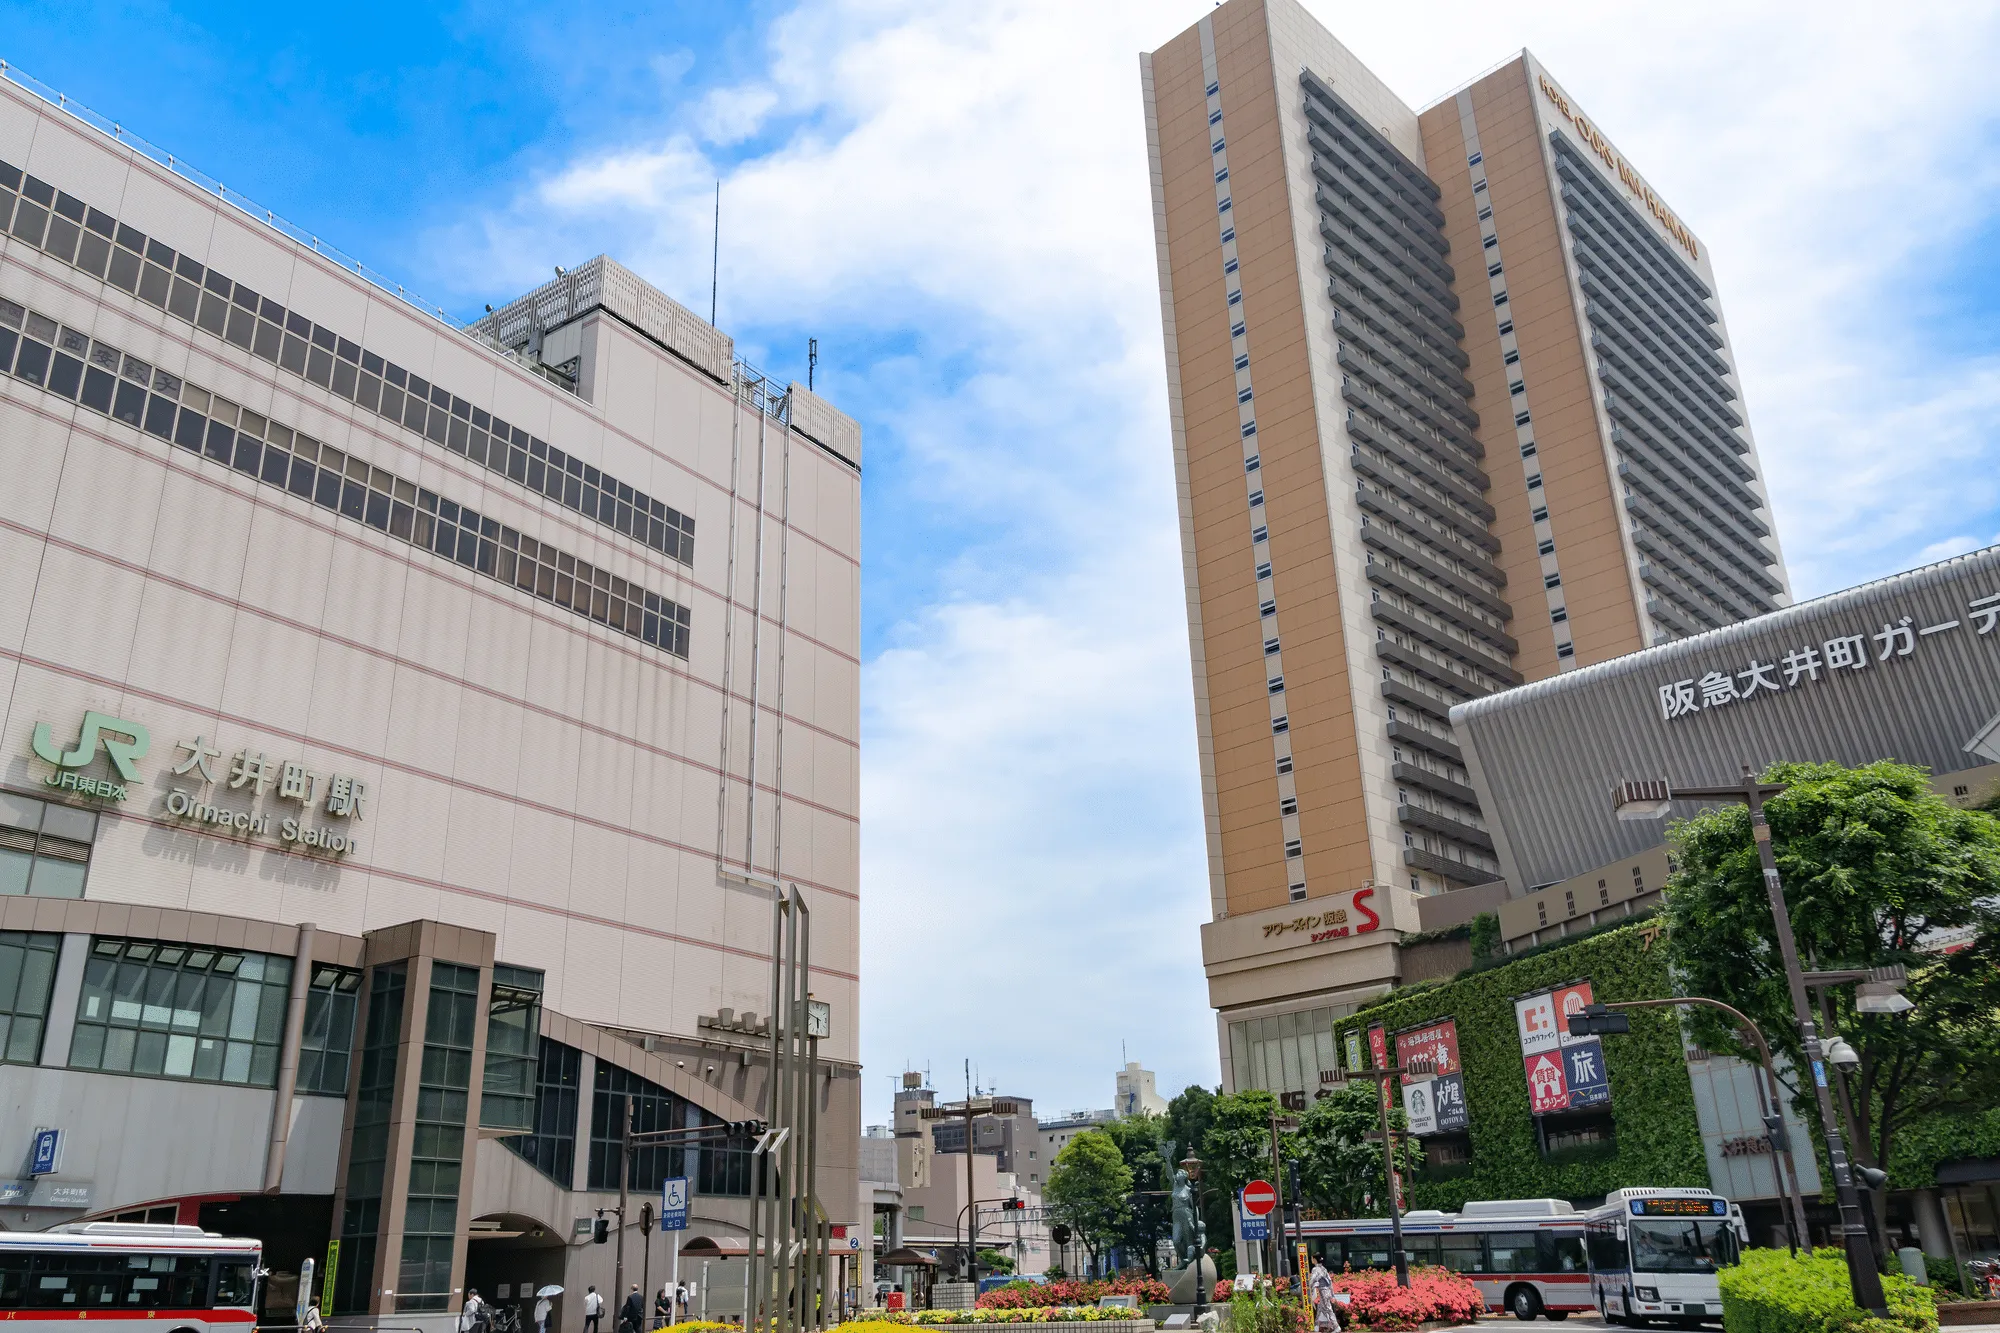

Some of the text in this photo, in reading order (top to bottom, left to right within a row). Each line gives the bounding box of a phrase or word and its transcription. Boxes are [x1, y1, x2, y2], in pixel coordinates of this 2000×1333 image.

[32, 710, 151, 784] JR
[45, 770, 129, 802] JR東日本
[171, 736, 370, 822] 大井町駅
[281, 816, 358, 856] Station
[1523, 1031, 1556, 1045] ココカラファイン
[1535, 1066, 1557, 1085] 賃貸
[1571, 1050, 1598, 1084] 旅
[1436, 1079, 1463, 1113] 大戸屋
[1411, 1115, 1432, 1125] STARBUCKS
[1415, 1121, 1429, 1129] COFFEE
[1440, 1115, 1464, 1126] OOTOYA
